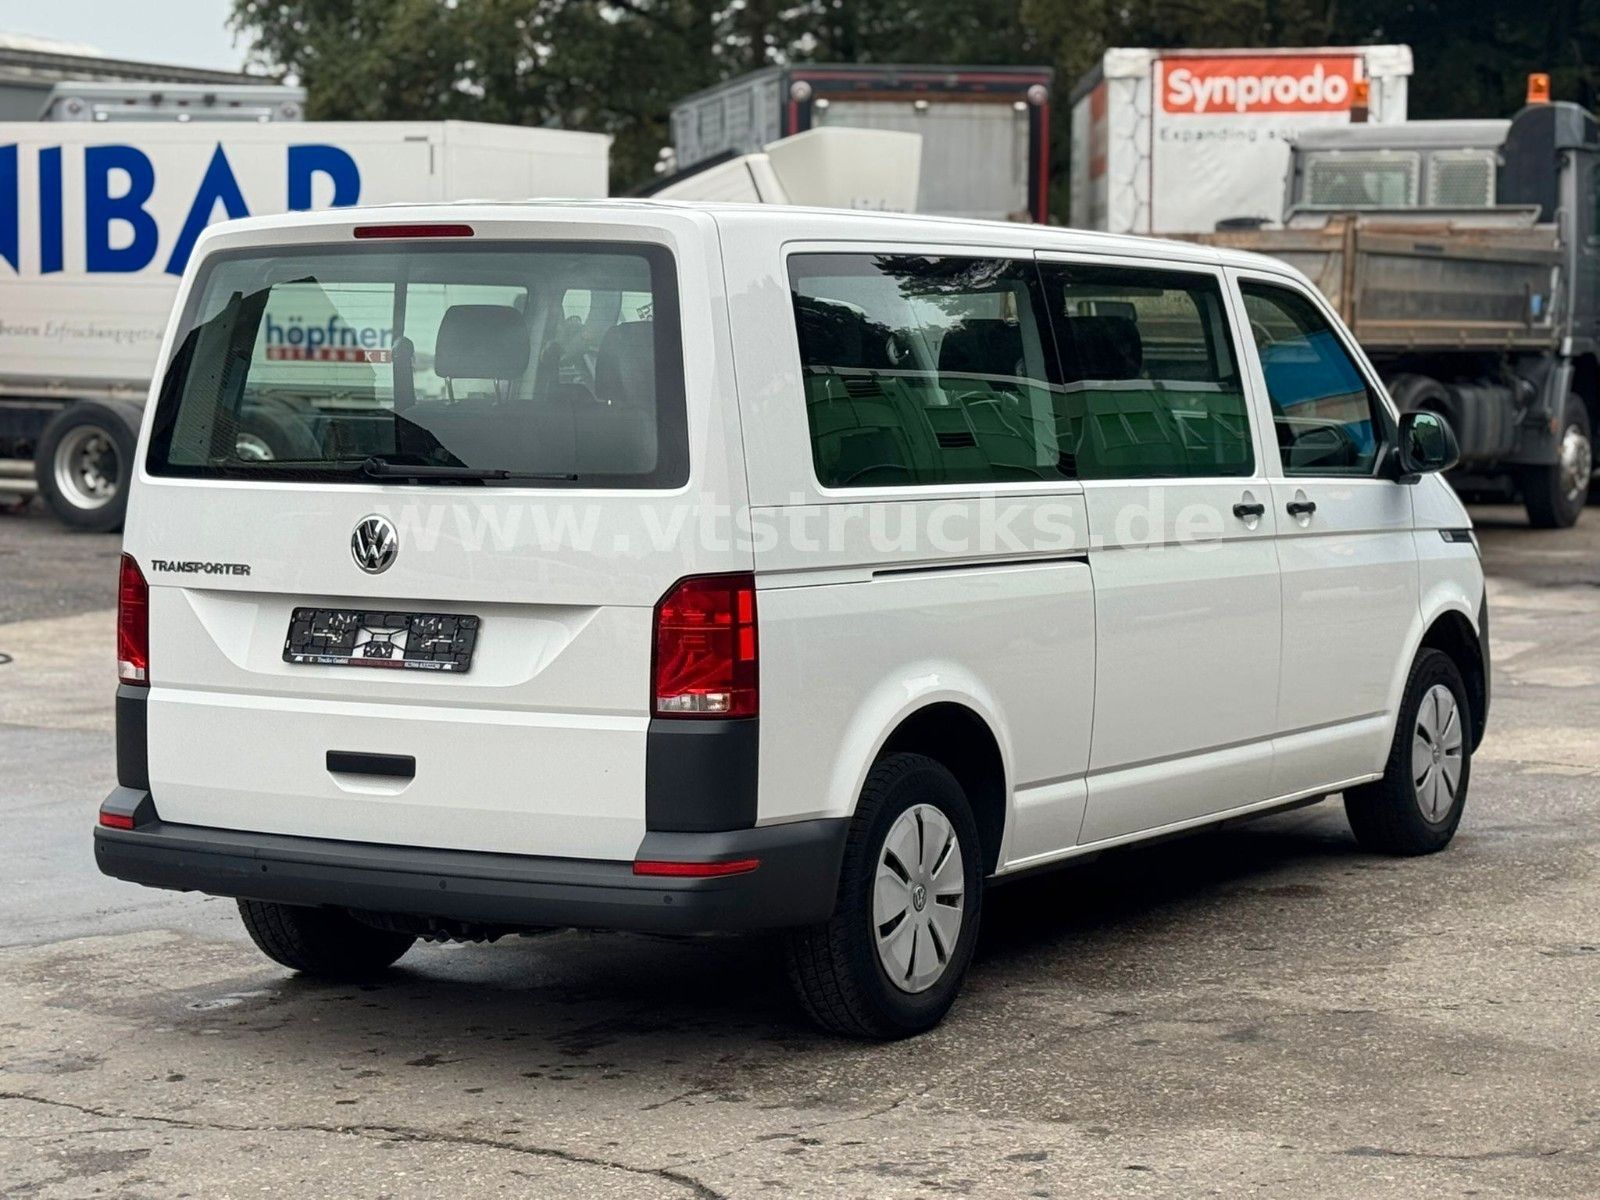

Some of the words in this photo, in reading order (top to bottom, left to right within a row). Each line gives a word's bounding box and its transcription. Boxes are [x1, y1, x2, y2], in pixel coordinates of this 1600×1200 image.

[1167, 62, 1348, 112] Synprodo
[1160, 127, 1257, 142] Expanding
[266, 313, 393, 351] höpfner
[151, 560, 251, 576] TRANSPORTER
